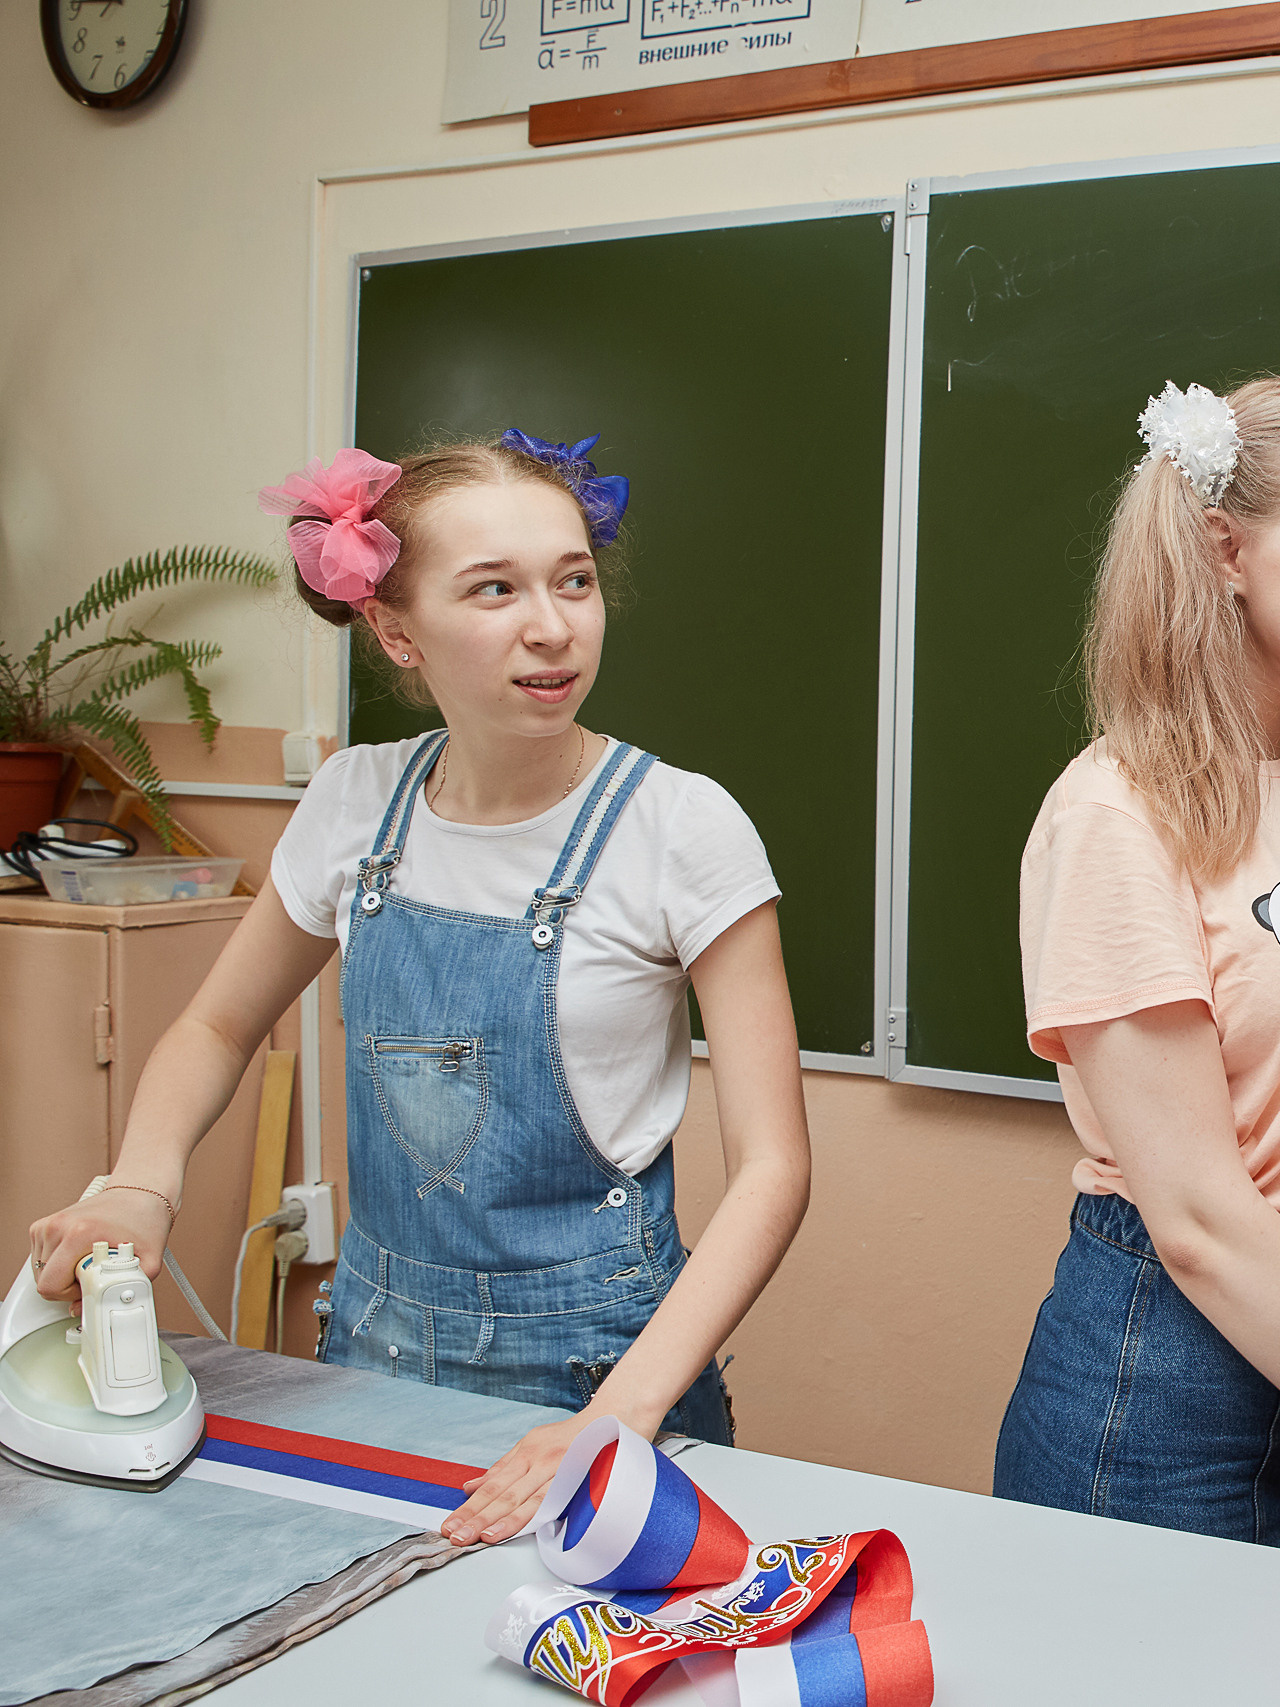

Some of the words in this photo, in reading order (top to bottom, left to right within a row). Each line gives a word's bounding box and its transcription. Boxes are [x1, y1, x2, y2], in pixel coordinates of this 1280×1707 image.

[480, 0, 505, 50] 2
[73, 27, 88, 53] 8
[639, 38, 729, 65] внешние
[89, 54, 103, 81] 7
[114, 63, 127, 90] 6
